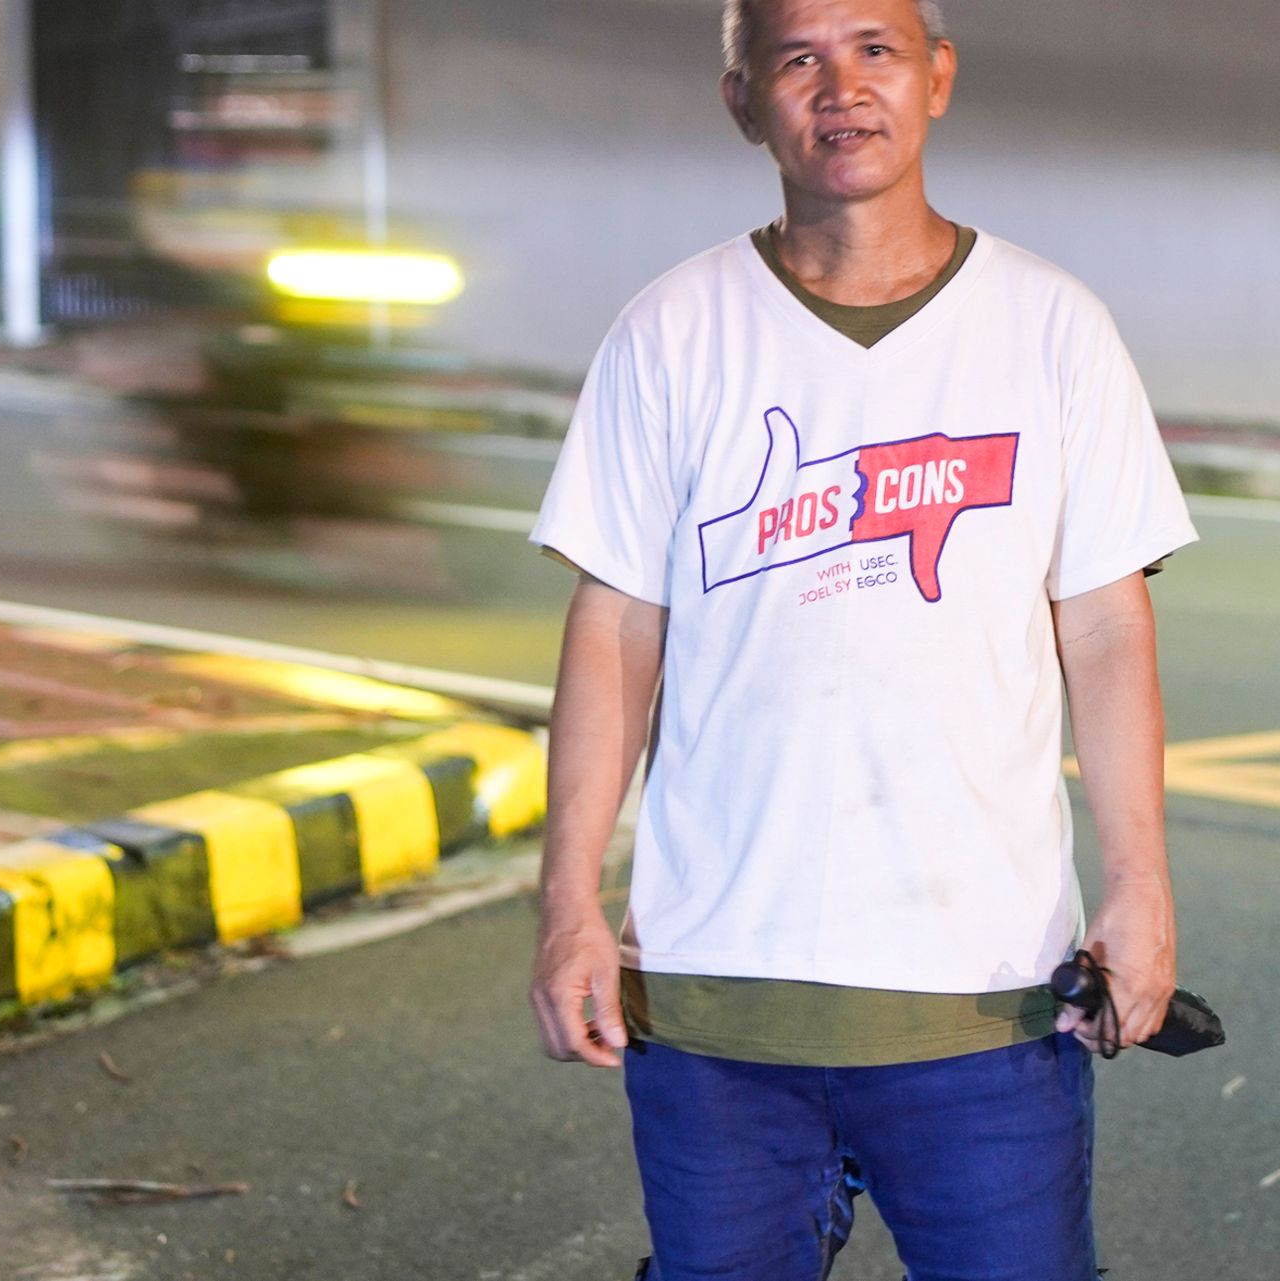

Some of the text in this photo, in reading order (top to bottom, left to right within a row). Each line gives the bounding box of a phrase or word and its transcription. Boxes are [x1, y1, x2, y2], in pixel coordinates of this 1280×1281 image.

[758, 458, 967, 555] PROS CONS
[816, 554, 898, 580] WITH USEC.
[798, 571, 897, 606] JOEL SY EGCO
